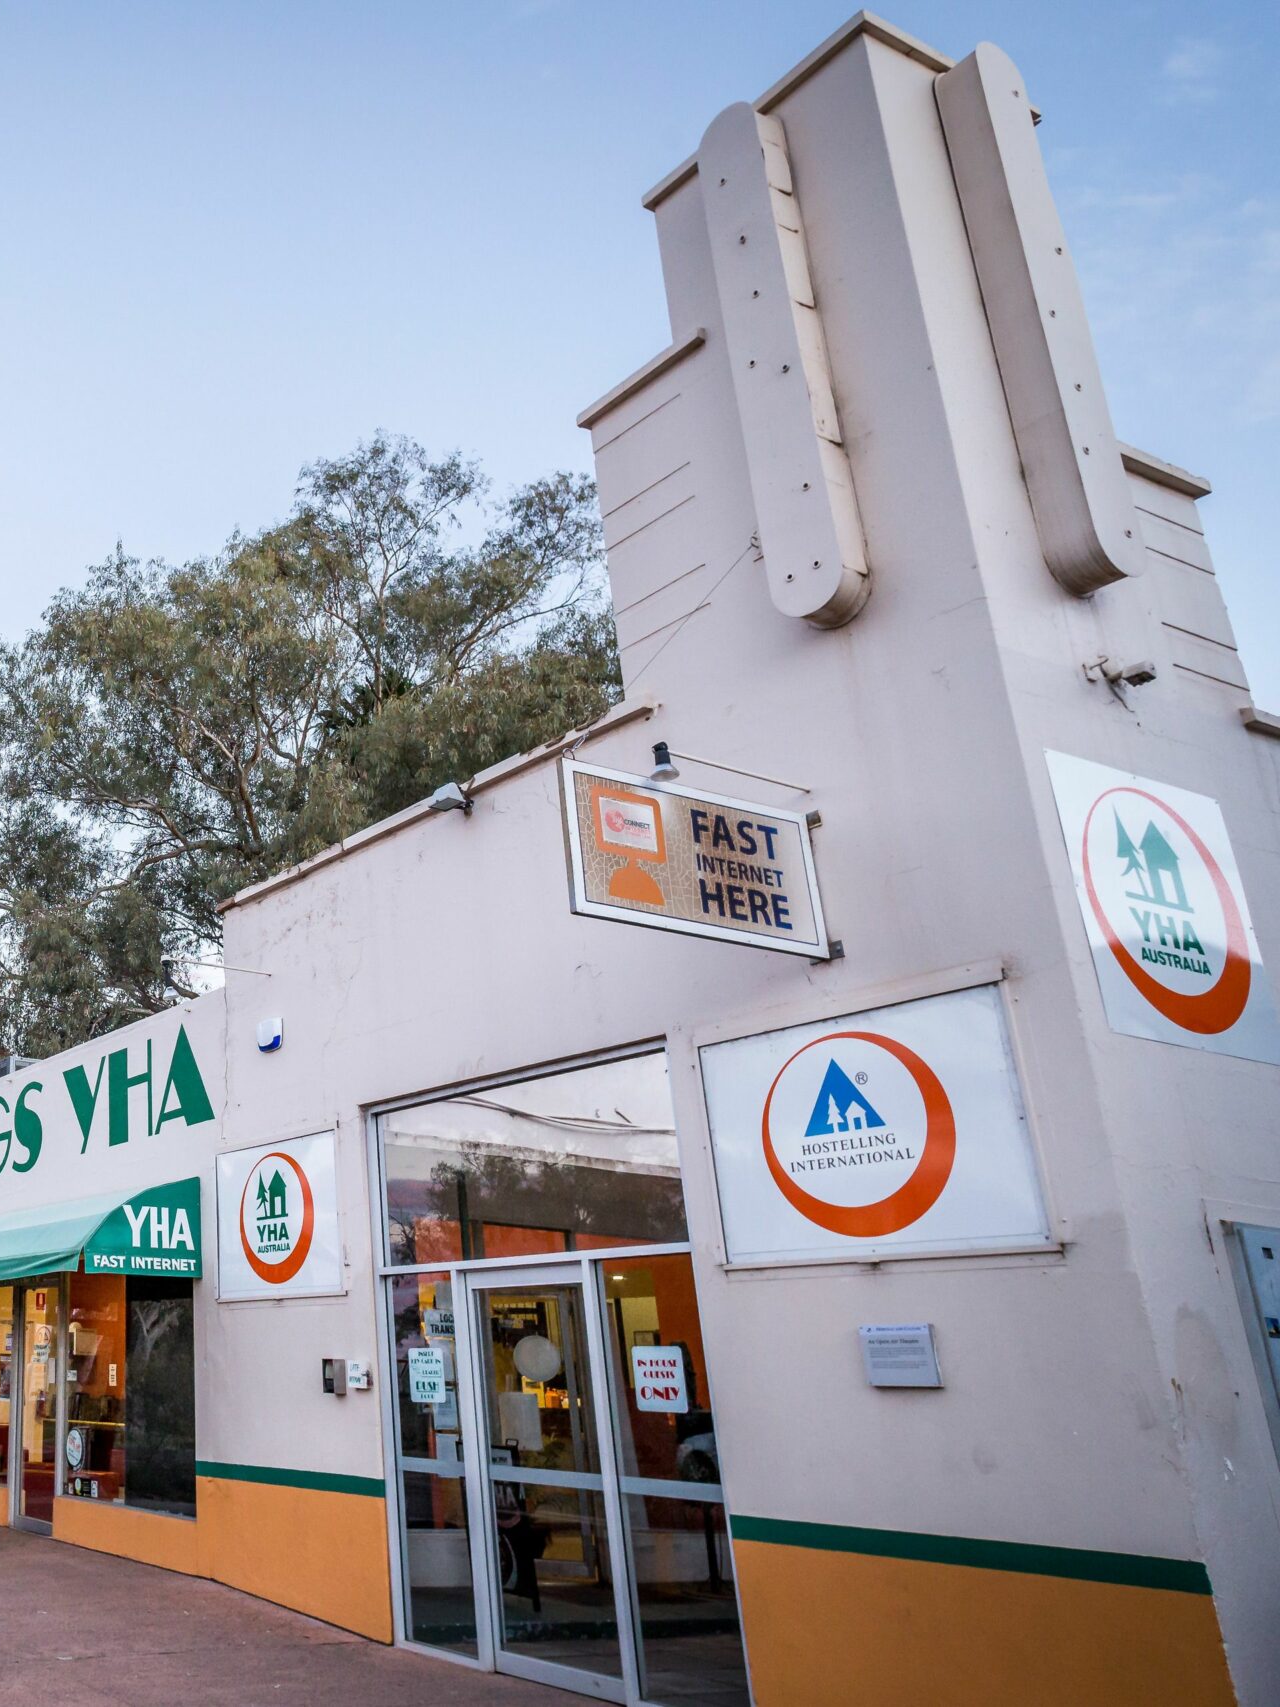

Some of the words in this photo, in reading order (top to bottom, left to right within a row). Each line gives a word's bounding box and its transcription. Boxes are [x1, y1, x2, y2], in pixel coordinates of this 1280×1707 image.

[690, 808, 778, 860] FAST
[696, 853, 784, 888] INTERNET
[698, 879, 793, 930] HERE
[1129, 906, 1206, 956] YHA
[1141, 947, 1213, 977] AUSTRALIA
[62, 1023, 216, 1155] YHA
[801, 1132, 897, 1156] HOSTELLING
[790, 1147, 916, 1173] INTERNATIONAL
[122, 1204, 195, 1251] YHA
[256, 1222, 289, 1243] YHA
[257, 1244, 291, 1254] AUSTRALIA
[93, 1254, 126, 1268] FAST
[131, 1256, 196, 1272] INTERNET
[637, 1359, 647, 1367] IN
[649, 1359, 677, 1367] HOUSE
[643, 1370, 675, 1379] GUESTS
[640, 1385, 680, 1401] ONLY
